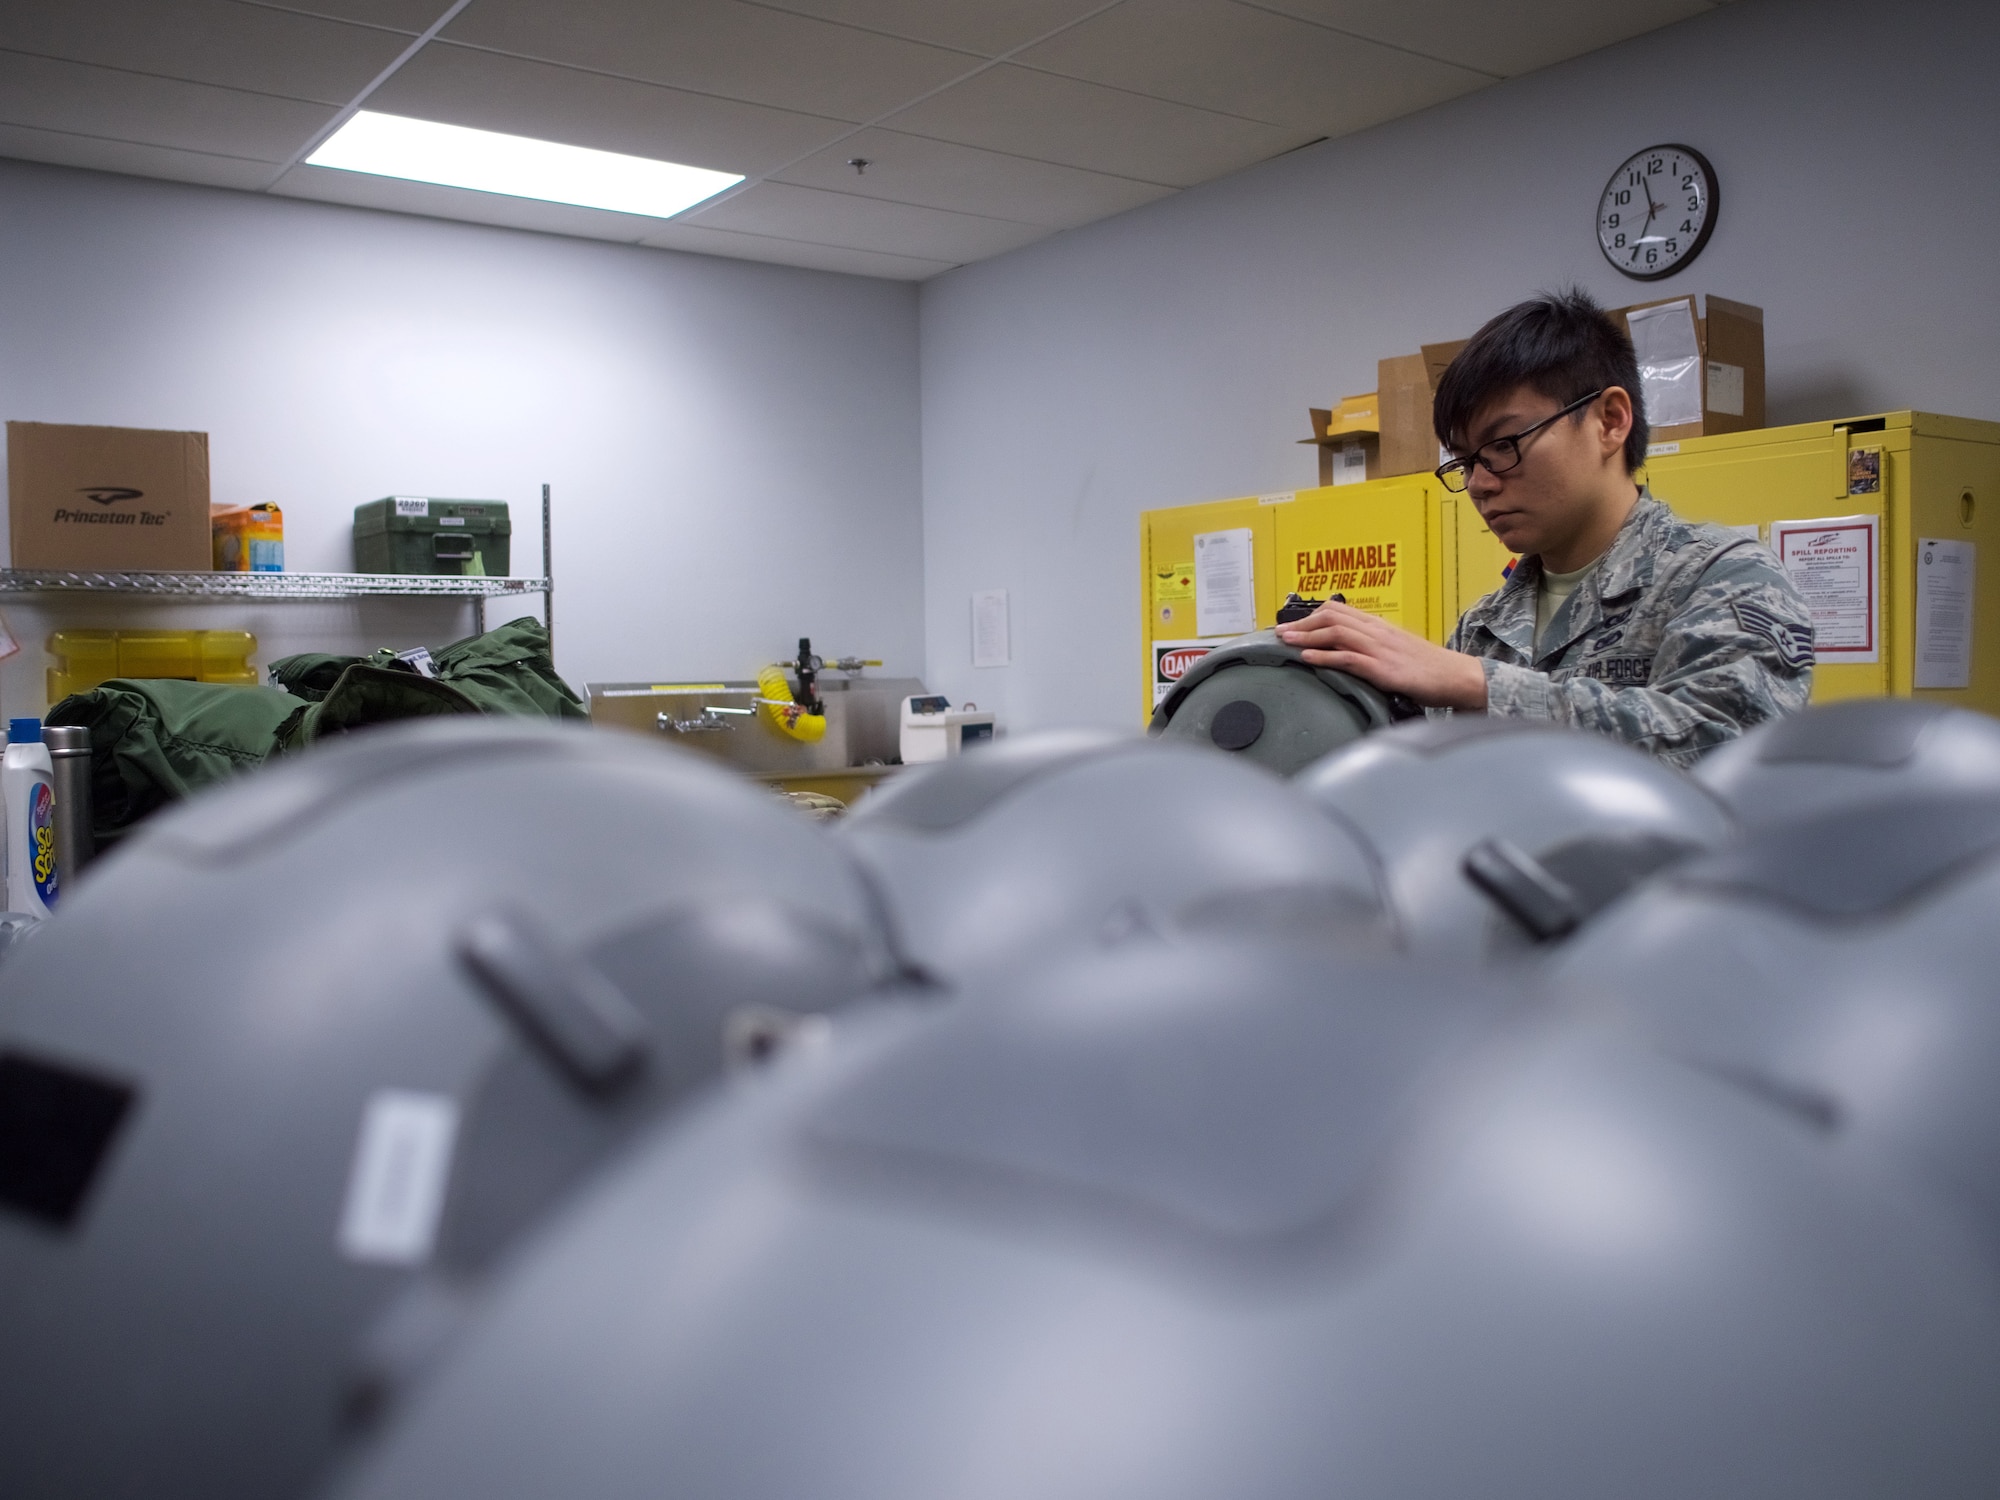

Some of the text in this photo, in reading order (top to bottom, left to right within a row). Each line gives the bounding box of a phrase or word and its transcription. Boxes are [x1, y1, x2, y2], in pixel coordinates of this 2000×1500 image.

[1647, 158, 1664, 176] 12
[1629, 171, 1641, 187] 11
[1682, 174, 1694, 191] 2
[1614, 189, 1631, 206] 10
[1687, 195, 1699, 212] 3
[1608, 213, 1620, 229] 9
[1679, 218, 1692, 234] 4
[1614, 233, 1626, 249] 8
[1665, 237, 1677, 254] 5
[1628, 245, 1640, 262] 7
[1646, 248, 1658, 264] 6
[54, 508, 136, 525] Princeton
[1296, 543, 1397, 575] FLAMMABLE
[1792, 546, 1858, 557] SPILL REPORTING
[1297, 568, 1397, 593] KEEP FIRE AWAY
[1606, 658, 1651, 680] FORCE
